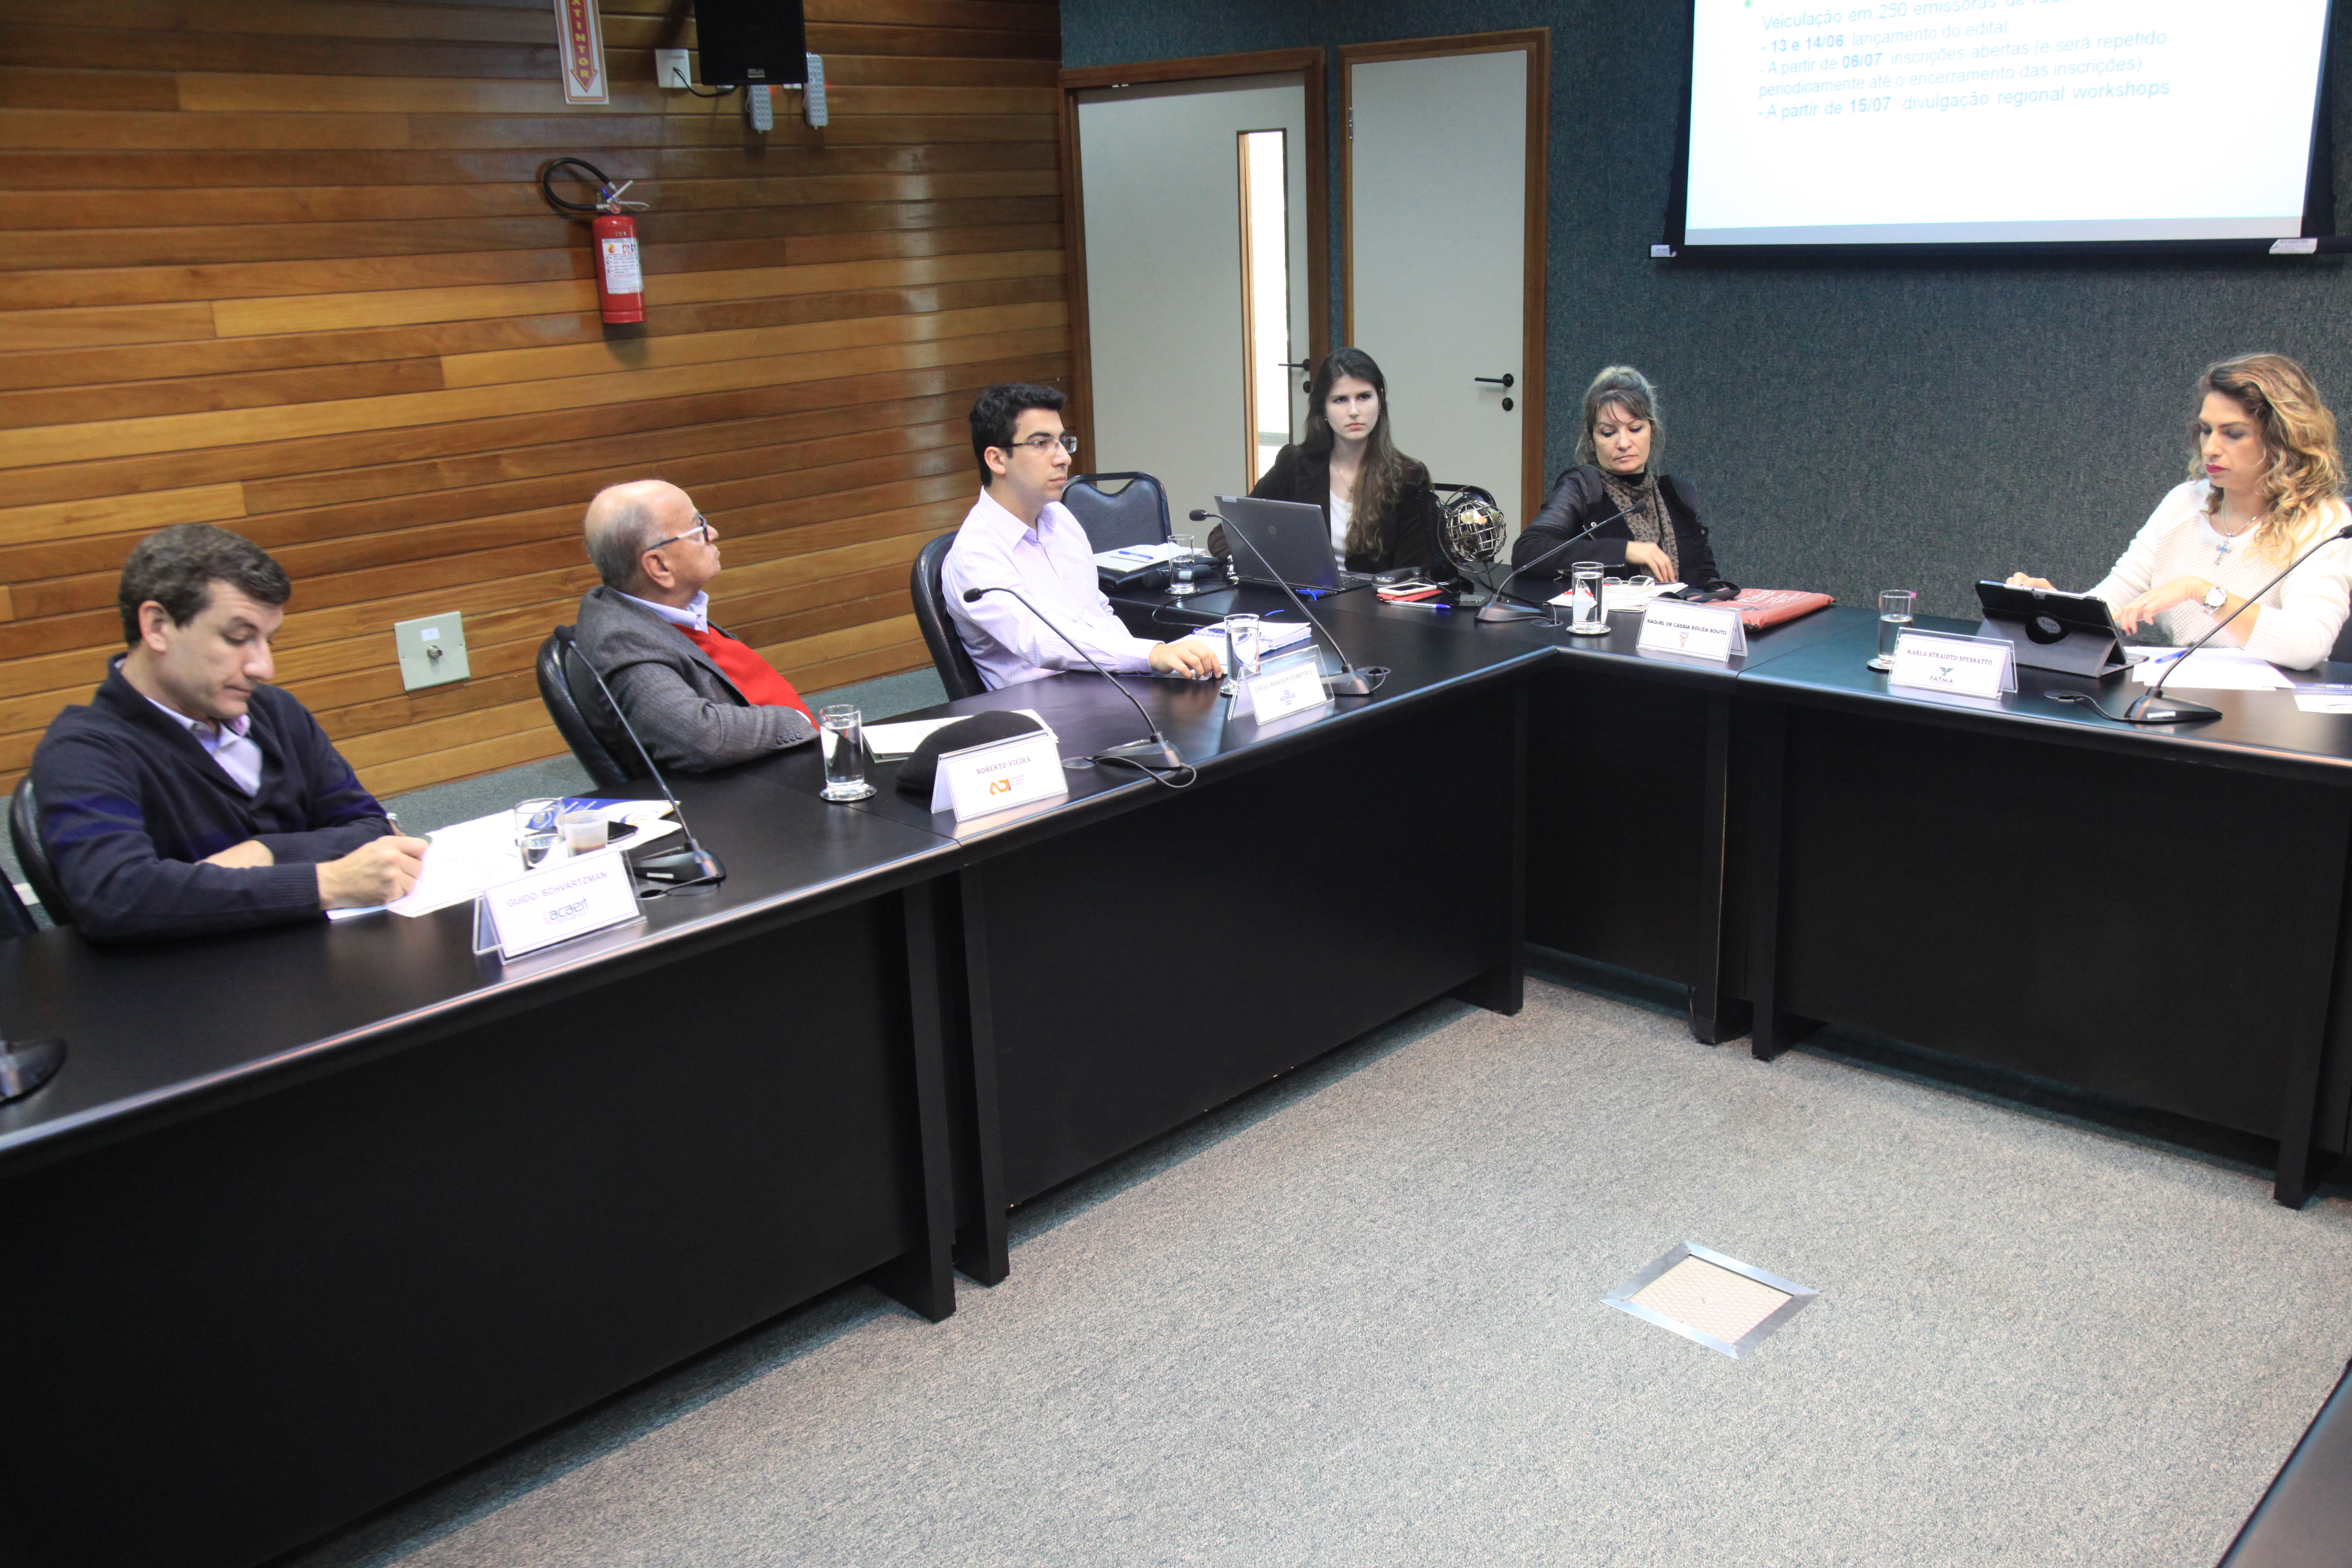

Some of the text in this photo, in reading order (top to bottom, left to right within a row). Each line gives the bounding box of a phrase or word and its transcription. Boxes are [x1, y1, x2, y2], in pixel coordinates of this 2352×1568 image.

[1762, 9, 1842, 29] Veiculação
[1849, 9, 1872, 21] em
[1879, 2, 1908, 19] 250
[1914, 0, 1997, 15] emissoras
[1771, 39, 1787, 53] 13
[1792, 41, 1800, 51] e
[1852, 27, 1937, 48] lançamento
[1942, 24, 1961, 38] do
[1965, 19, 2009, 36] edital
[1781, 58, 1817, 77] partir
[1820, 57, 1838, 70] de
[1891, 47, 1965, 66] inscrições
[1970, 43, 2030, 59] abertas
[2034, 40, 2050, 57] (e
[2055, 35, 2091, 52] será
[2097, 30, 2168, 52] repetido
[1759, 55, 2143, 100] periodicamente até o encerramento das inscrições)
[1781, 101, 1819, 122] partir
[1824, 101, 1843, 115] de
[1903, 91, 1989, 112] divulgação
[1997, 85, 2066, 107] regional
[2073, 80, 2170, 100] workshops
[1928, 652, 1958, 660] STRAIOTO
[1958, 656, 1993, 665] SPESSATTO
[1254, 669, 1313, 692] DIEGO WANDER DEMETRIO
[1929, 675, 1954, 684] FATMA
[1279, 692, 1297, 702] SEBRAE
[976, 756, 1032, 775] ROBERTO VIEIRA
[508, 871, 608, 907] GUIDO SCHVARTZMAN
[548, 897, 589, 921] acaert
